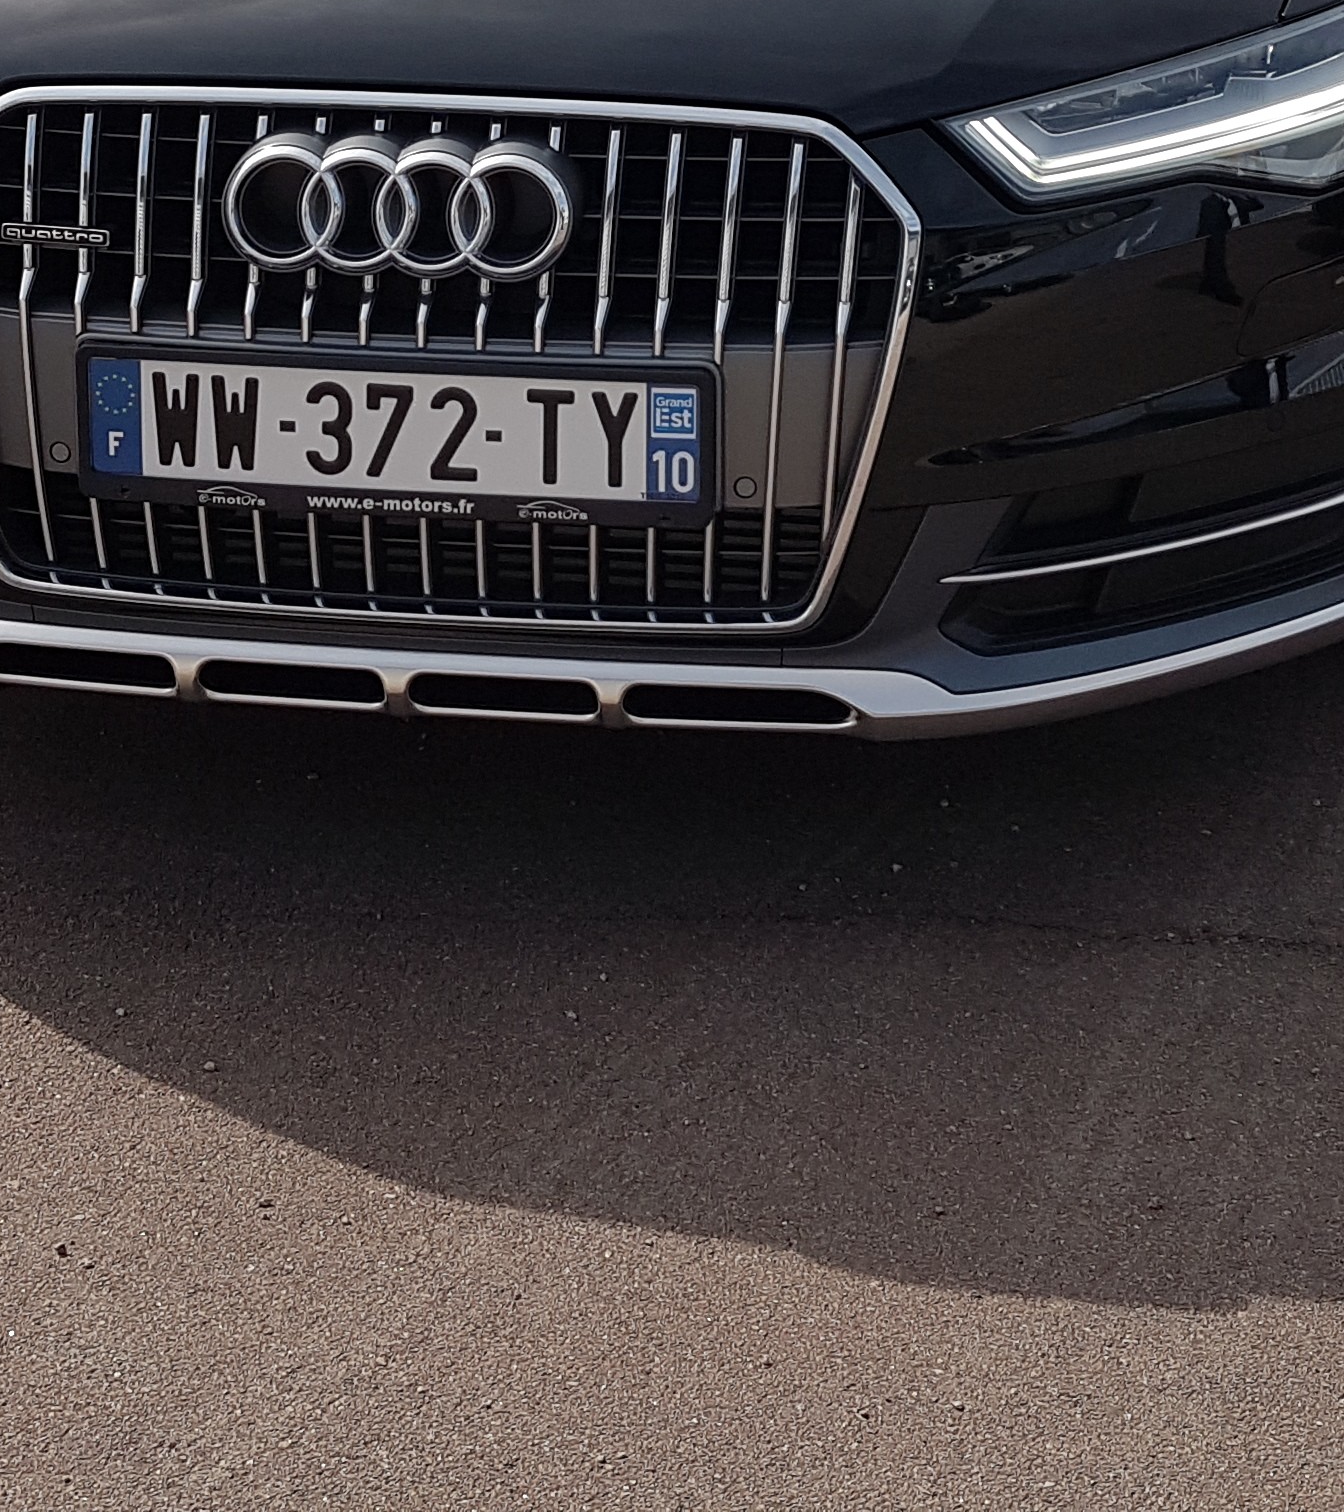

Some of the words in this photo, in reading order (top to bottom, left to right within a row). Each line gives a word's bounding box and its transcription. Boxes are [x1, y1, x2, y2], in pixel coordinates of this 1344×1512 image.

[6, 228, 104, 242] quattro
[656, 396, 692, 408] Grand
[656, 408, 692, 428] Est
[152, 371, 638, 488] WW-372-TY
[108, 431, 124, 456] F
[652, 450, 695, 493] 10
[307, 496, 475, 514] www.e-motors.fr
